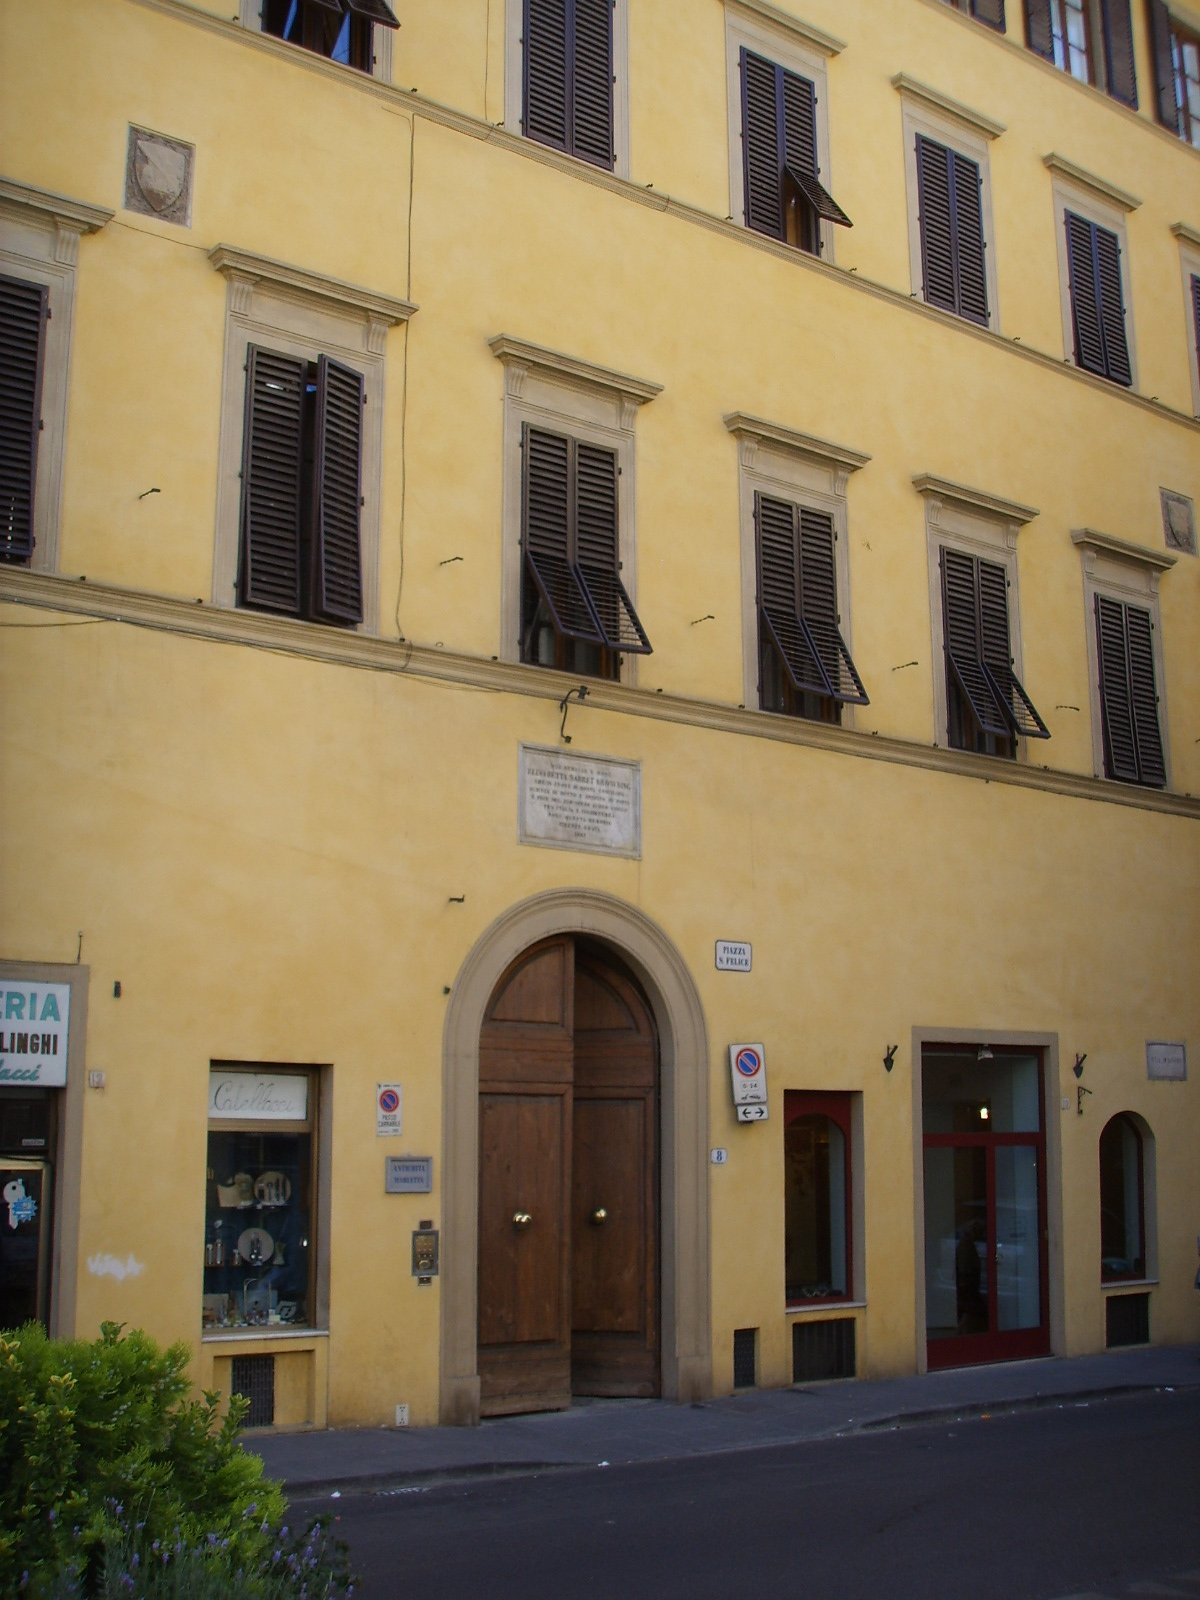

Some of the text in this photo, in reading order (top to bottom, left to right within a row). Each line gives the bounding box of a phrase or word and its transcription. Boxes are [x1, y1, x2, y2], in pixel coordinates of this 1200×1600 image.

[723, 946, 746, 955] PIAZZA
[726, 957, 749, 967] FELICE
[716, 1150, 722, 1161] 8
